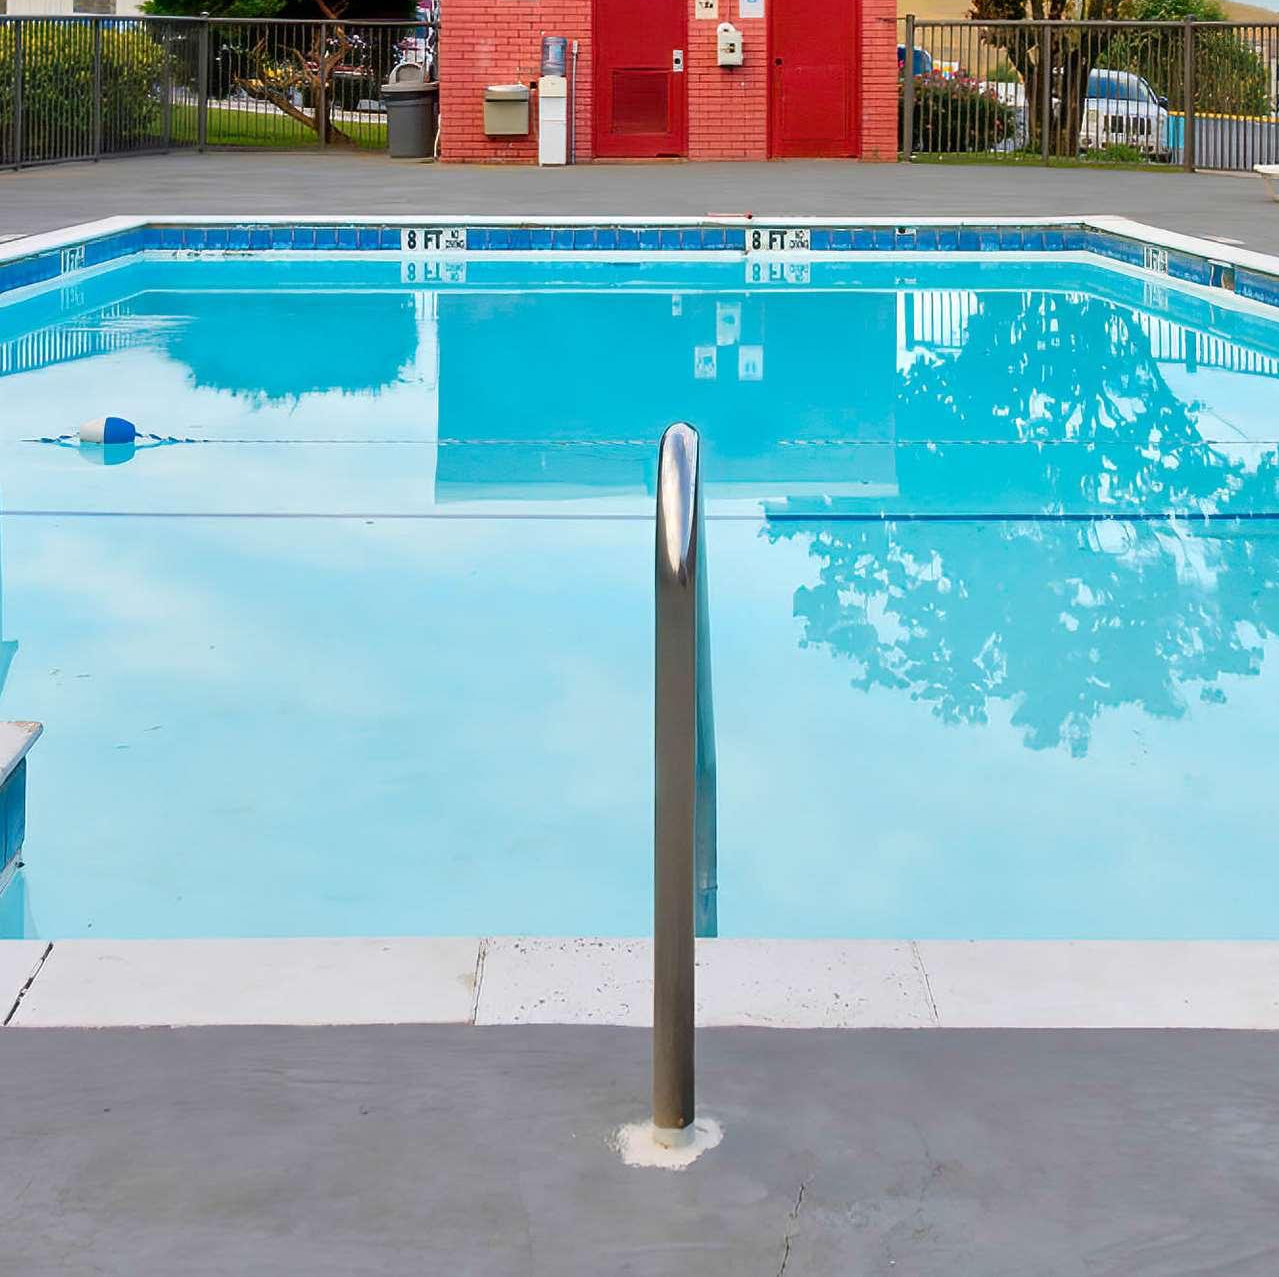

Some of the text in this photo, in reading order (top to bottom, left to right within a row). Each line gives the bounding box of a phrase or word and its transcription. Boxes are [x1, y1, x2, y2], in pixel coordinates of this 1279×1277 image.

[407, 230, 443, 250] 8 FT
[752, 230, 787, 251] 8 FT
